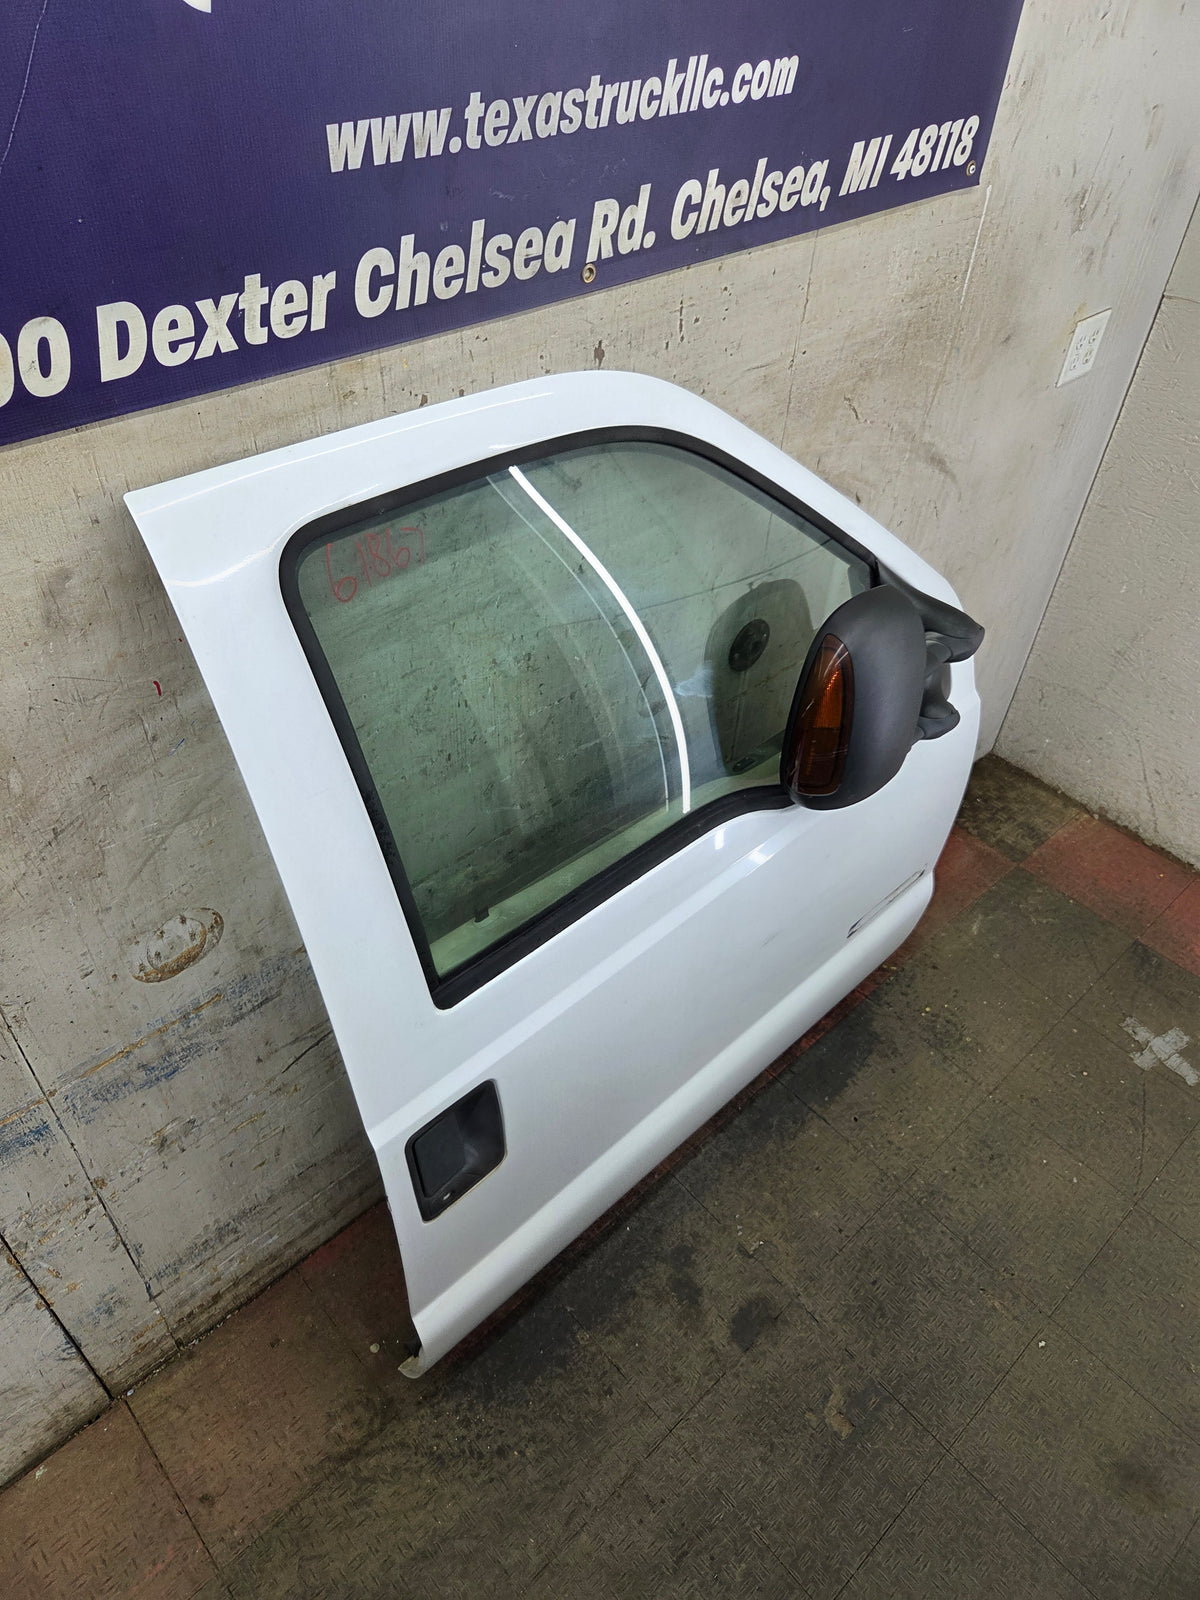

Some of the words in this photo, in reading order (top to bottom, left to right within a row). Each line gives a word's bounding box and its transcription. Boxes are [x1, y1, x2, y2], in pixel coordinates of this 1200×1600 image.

[326, 54, 800, 173] www.texastruckllc.com
[0, 316, 71, 408] 0
[96, 270, 337, 383] Dexter
[354, 218, 577, 318] Chelsea
[586, 183, 656, 264] Rd.
[671, 156, 831, 241] Chelsea,
[838, 133, 894, 197] MI
[889, 114, 980, 182] 48118
[325, 526, 426, 603] 61867
